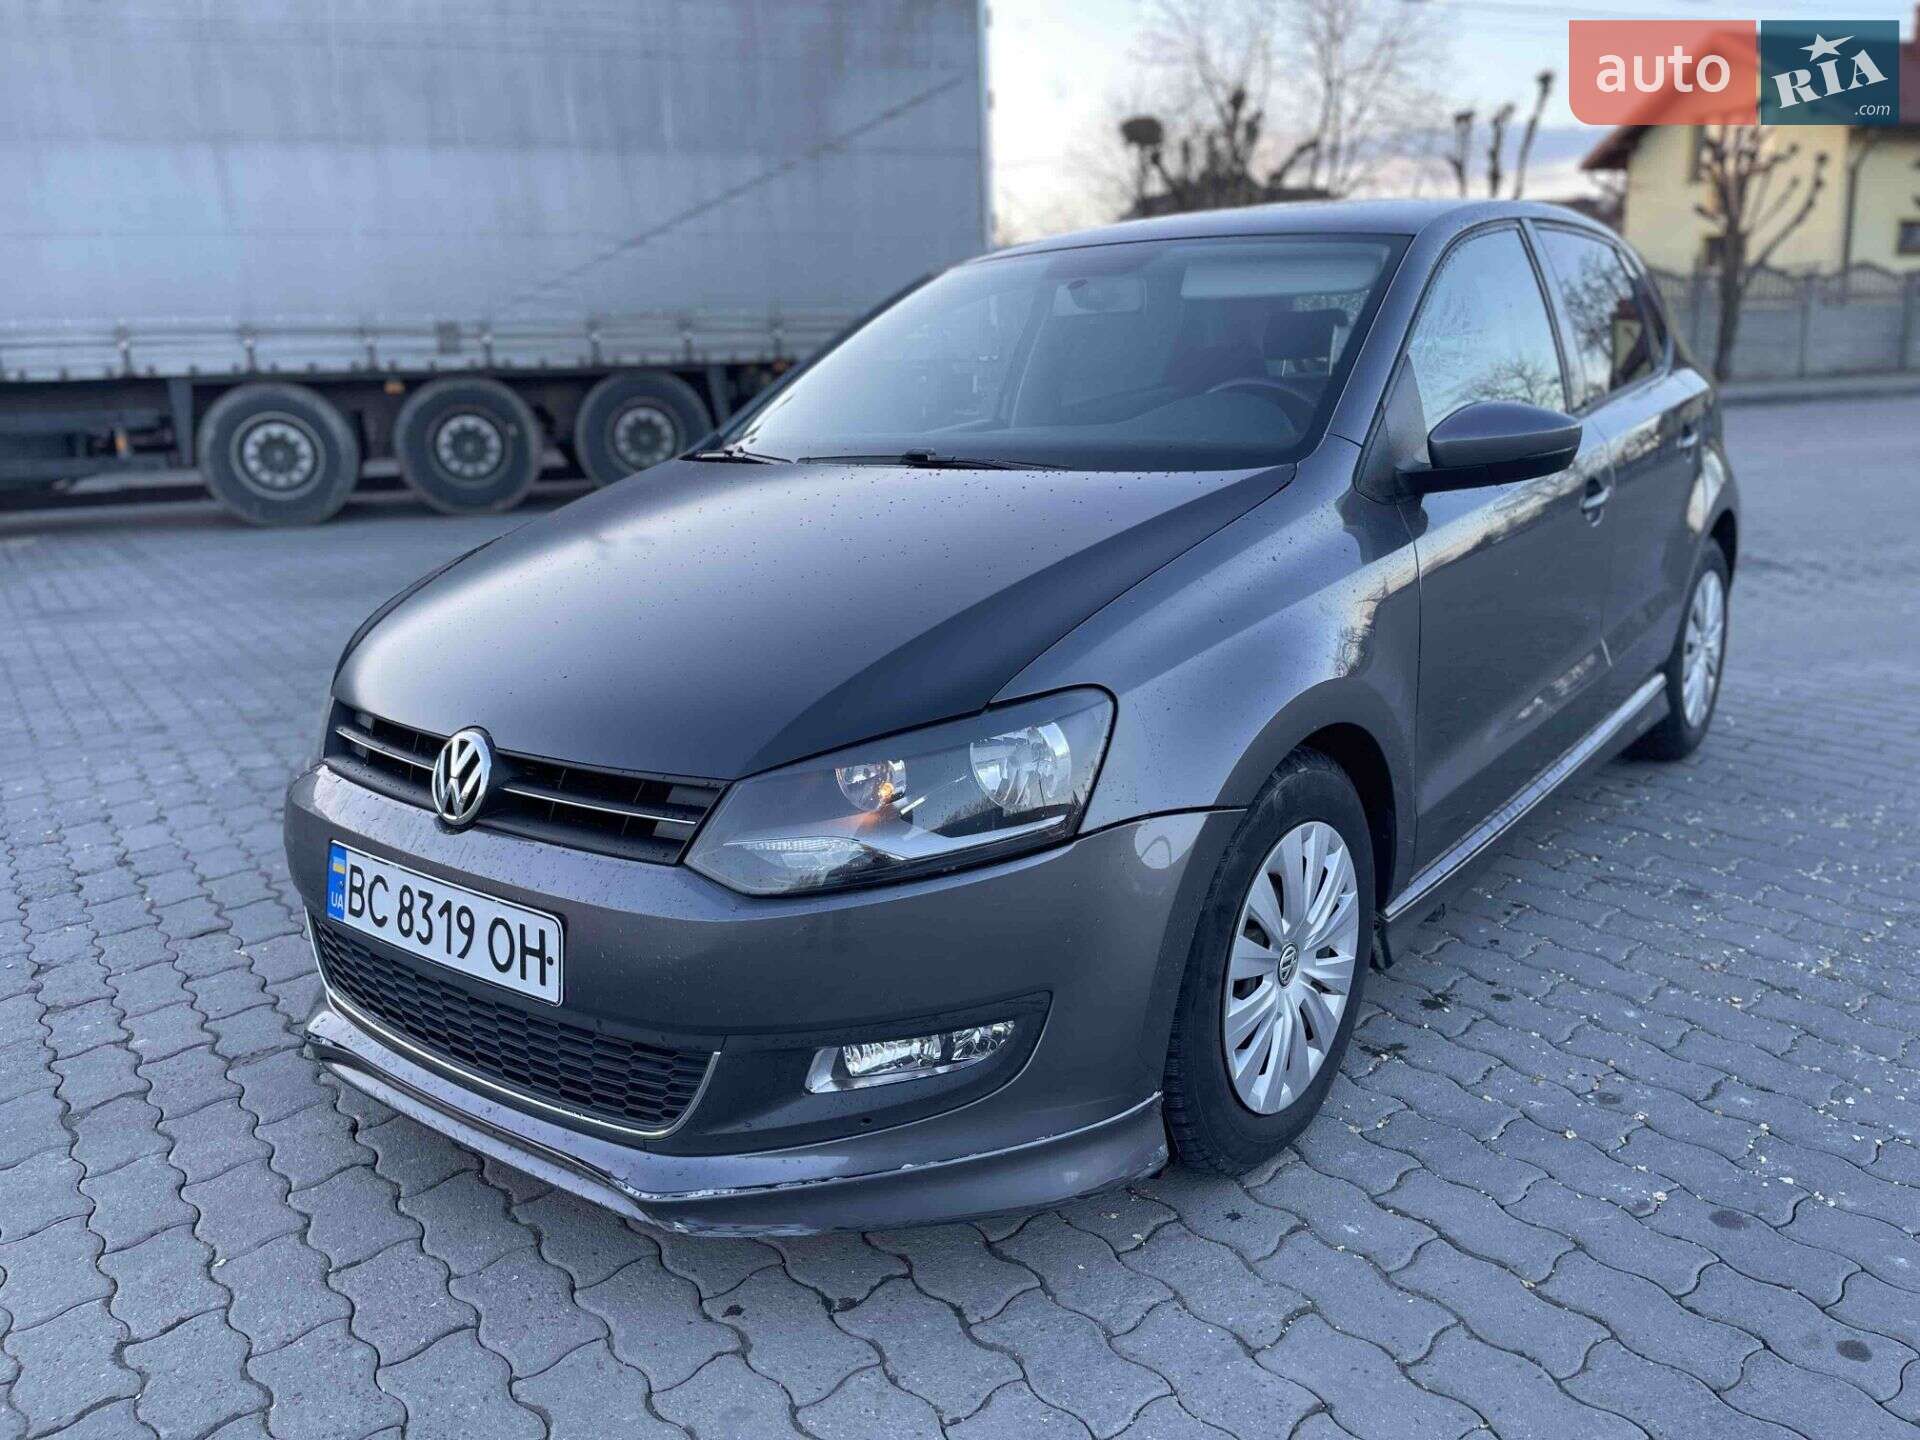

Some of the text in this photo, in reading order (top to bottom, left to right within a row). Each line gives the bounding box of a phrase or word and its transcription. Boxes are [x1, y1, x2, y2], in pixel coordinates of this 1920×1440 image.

[331, 891, 344, 910] UA
[348, 864, 547, 986] BC 8319 OH
